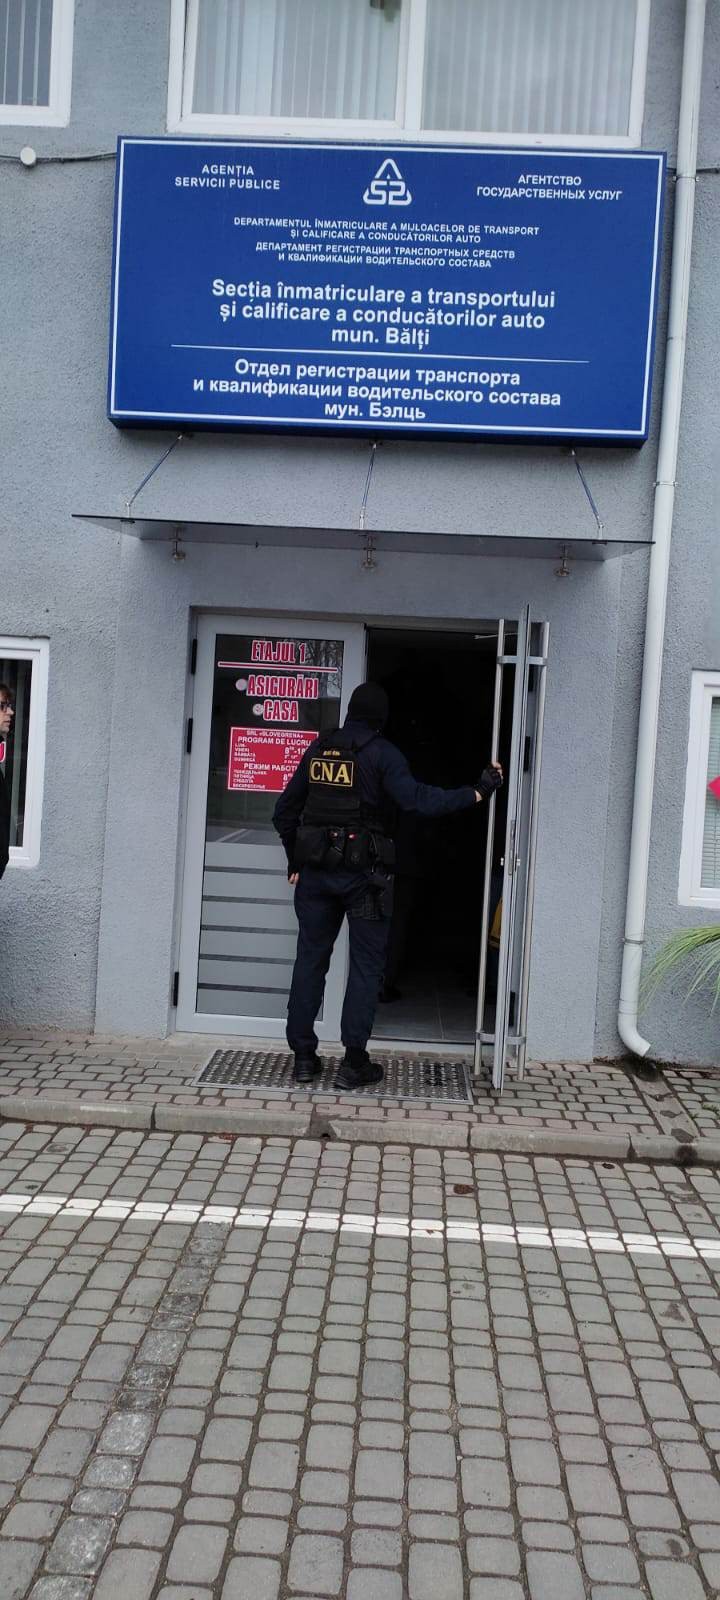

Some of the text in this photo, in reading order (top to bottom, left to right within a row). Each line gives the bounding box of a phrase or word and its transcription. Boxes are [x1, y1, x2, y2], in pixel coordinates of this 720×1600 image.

[201, 164, 254, 177] AGENȚIA
[518, 174, 582, 185] АГЕНТСТВО
[175, 177, 280, 190] SERVICII PUBLICE
[476, 186, 623, 201] ГОСУДАРСТВЕННЫХ УСЛУГ
[234, 217, 540, 235] DEPARTAMENTUL ÎNMATRICULARE A MIJLOACELOR DE TRANSPORT
[290, 229, 481, 243] ȘI CALIFICARE A CONDUCĂTORILOR AUTO
[255, 242, 515, 260] ДЕПАРТАМЕНТ РЕГИСТРАЦИИ ТРАНСПОРТНЫХ СРЕДСТВ
[278, 253, 491, 268] И КВАЛИФИКАЦИИ ВОДИТЕЛЬСКОГО СОСТАВА
[212, 279, 556, 309] Secția înmatriculare a transportului
[220, 301, 545, 328] și calificare a conducătorilor auto
[332, 327, 430, 350] mun. Bălți
[235, 358, 521, 388] Отдел регистрации транспорта
[193, 379, 561, 406] и квалификации водительского состава
[324, 402, 426, 421] мун. Бэлць
[251, 640, 307, 664] ETAJUL 1
[246, 674, 319, 699] ASIGURĂRI
[263, 699, 299, 722] CASA
[237, 736, 274, 744] PROGRAM
[243, 762, 270, 771] РЕЖИМ
[310, 761, 350, 783] CNA
